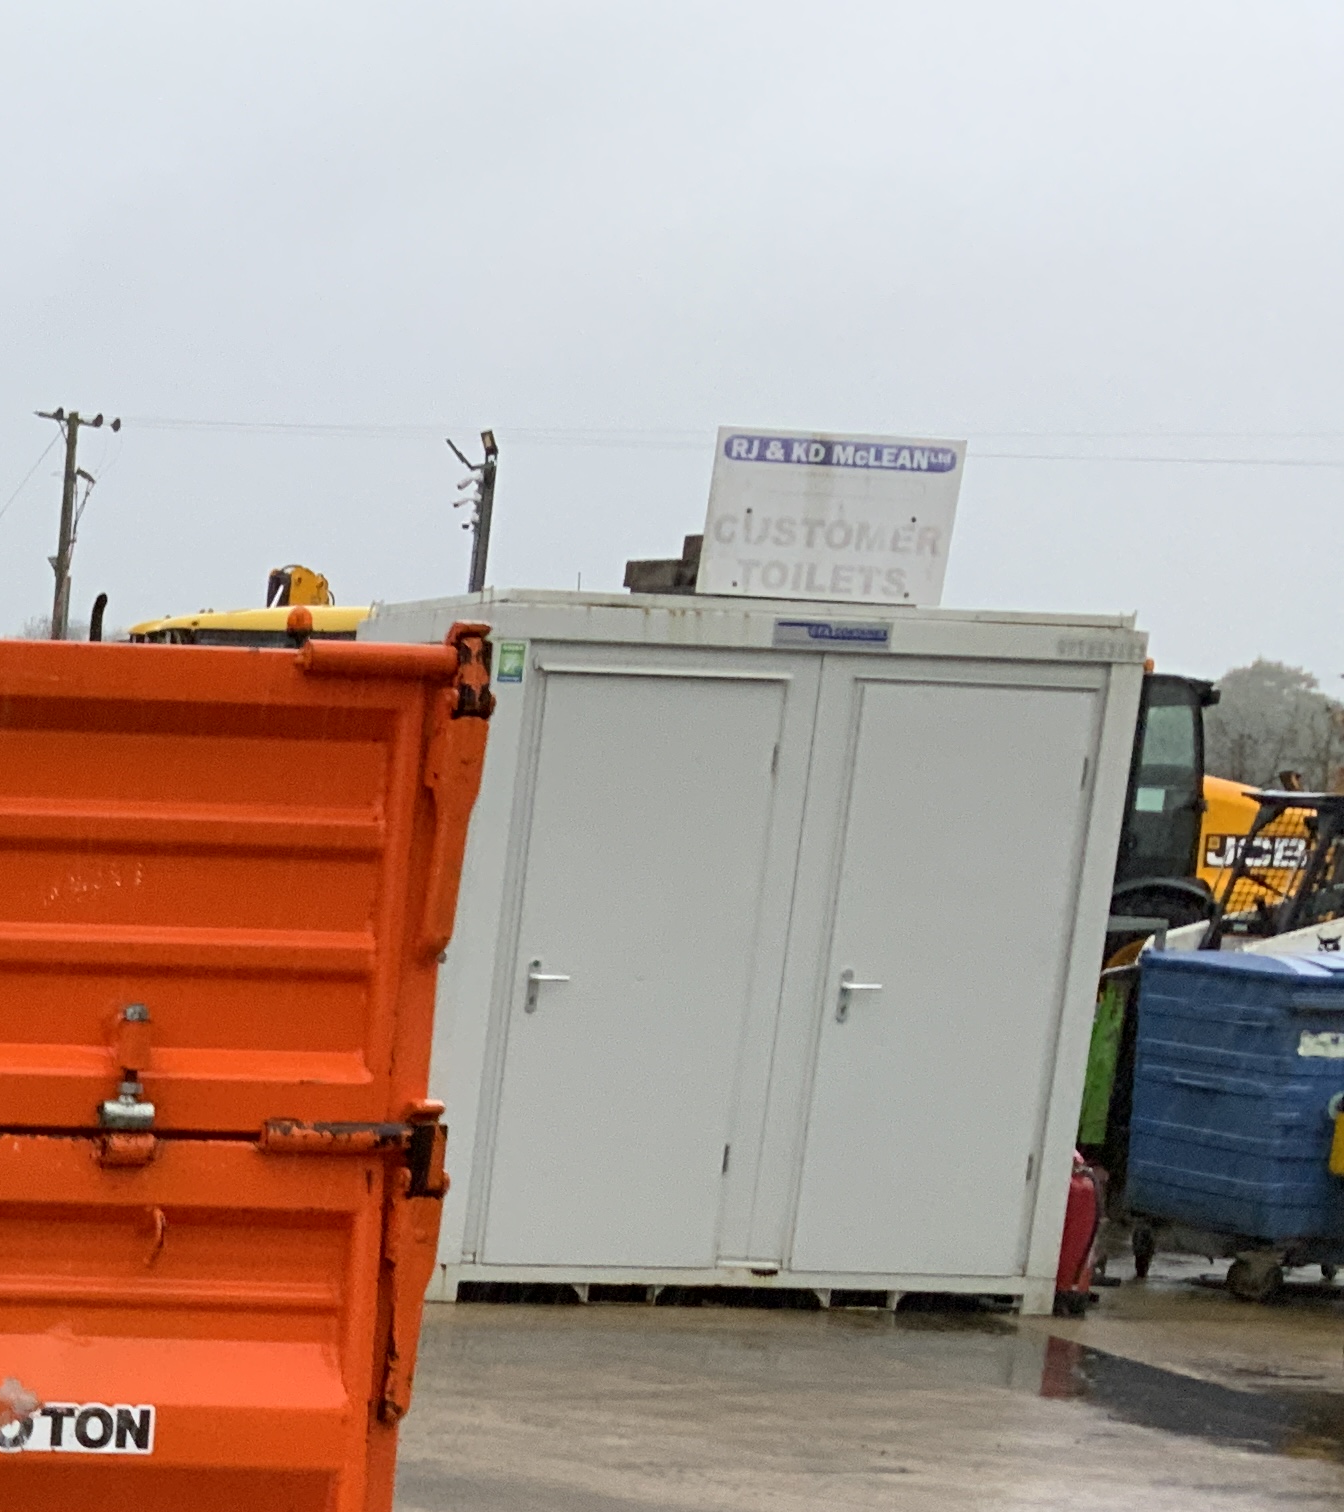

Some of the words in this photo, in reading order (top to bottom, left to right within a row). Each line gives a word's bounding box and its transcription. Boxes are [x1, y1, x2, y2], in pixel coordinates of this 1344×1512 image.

[731, 437, 759, 460] RJ
[765, 440, 785, 461] &
[791, 442, 825, 463] KD
[831, 444, 929, 470] McLEAN
[713, 512, 942, 557] CUSTOMER
[736, 558, 909, 598] TOILETS
[1206, 835, 1308, 867] JCB
